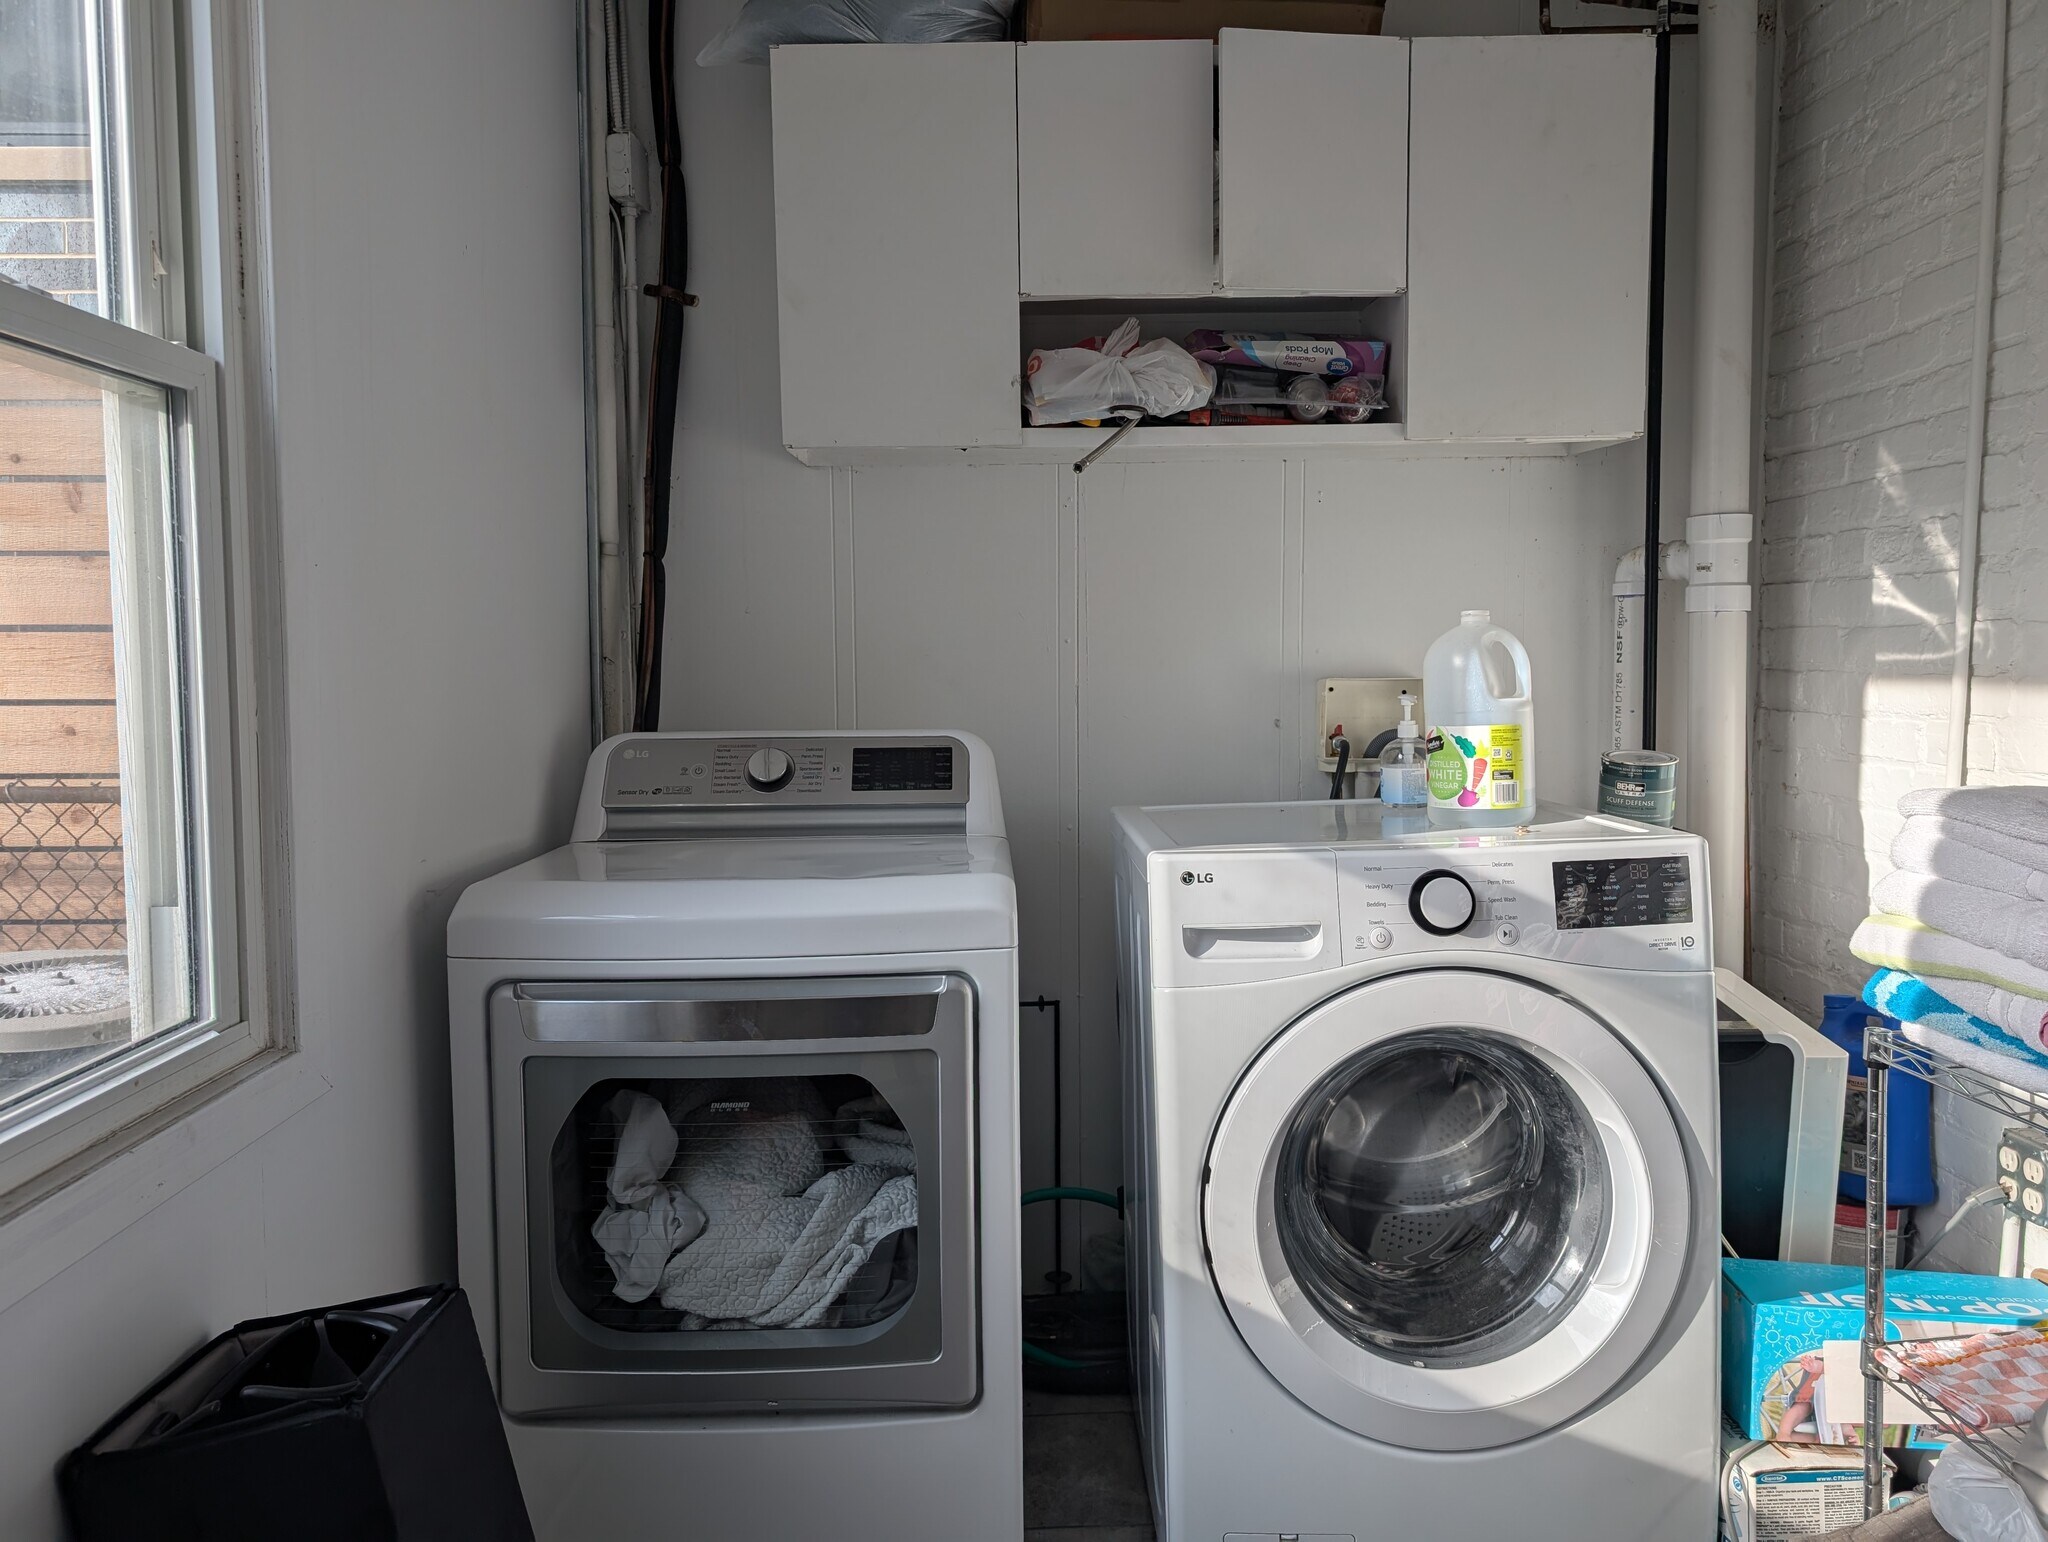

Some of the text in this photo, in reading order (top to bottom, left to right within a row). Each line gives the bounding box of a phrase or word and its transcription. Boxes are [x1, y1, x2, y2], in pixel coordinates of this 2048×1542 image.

[1285, 345, 1334, 355] Mop Pads
[1284, 354, 1317, 363] Cleaning
[1283, 360, 1302, 368] Deep
[1330, 364, 1350, 372] Great
[1615, 672, 1623, 703] D1785
[1614, 705, 1622, 734] ASTM
[1430, 760, 1461, 769] DISTILLED
[1431, 769, 1463, 781] WHITE
[1616, 782, 1636, 791] BEHR
[1606, 795, 1625, 804] SCUFF
[1625, 799, 1655, 807] DEFENSE
[1197, 873, 1214, 883] LG
[1603, 914, 1614, 922] Spin
[1680, 936, 1695, 948] 10
[1915, 1293, 1981, 1302] booster
[1960, 1301, 2048, 1317] OP
